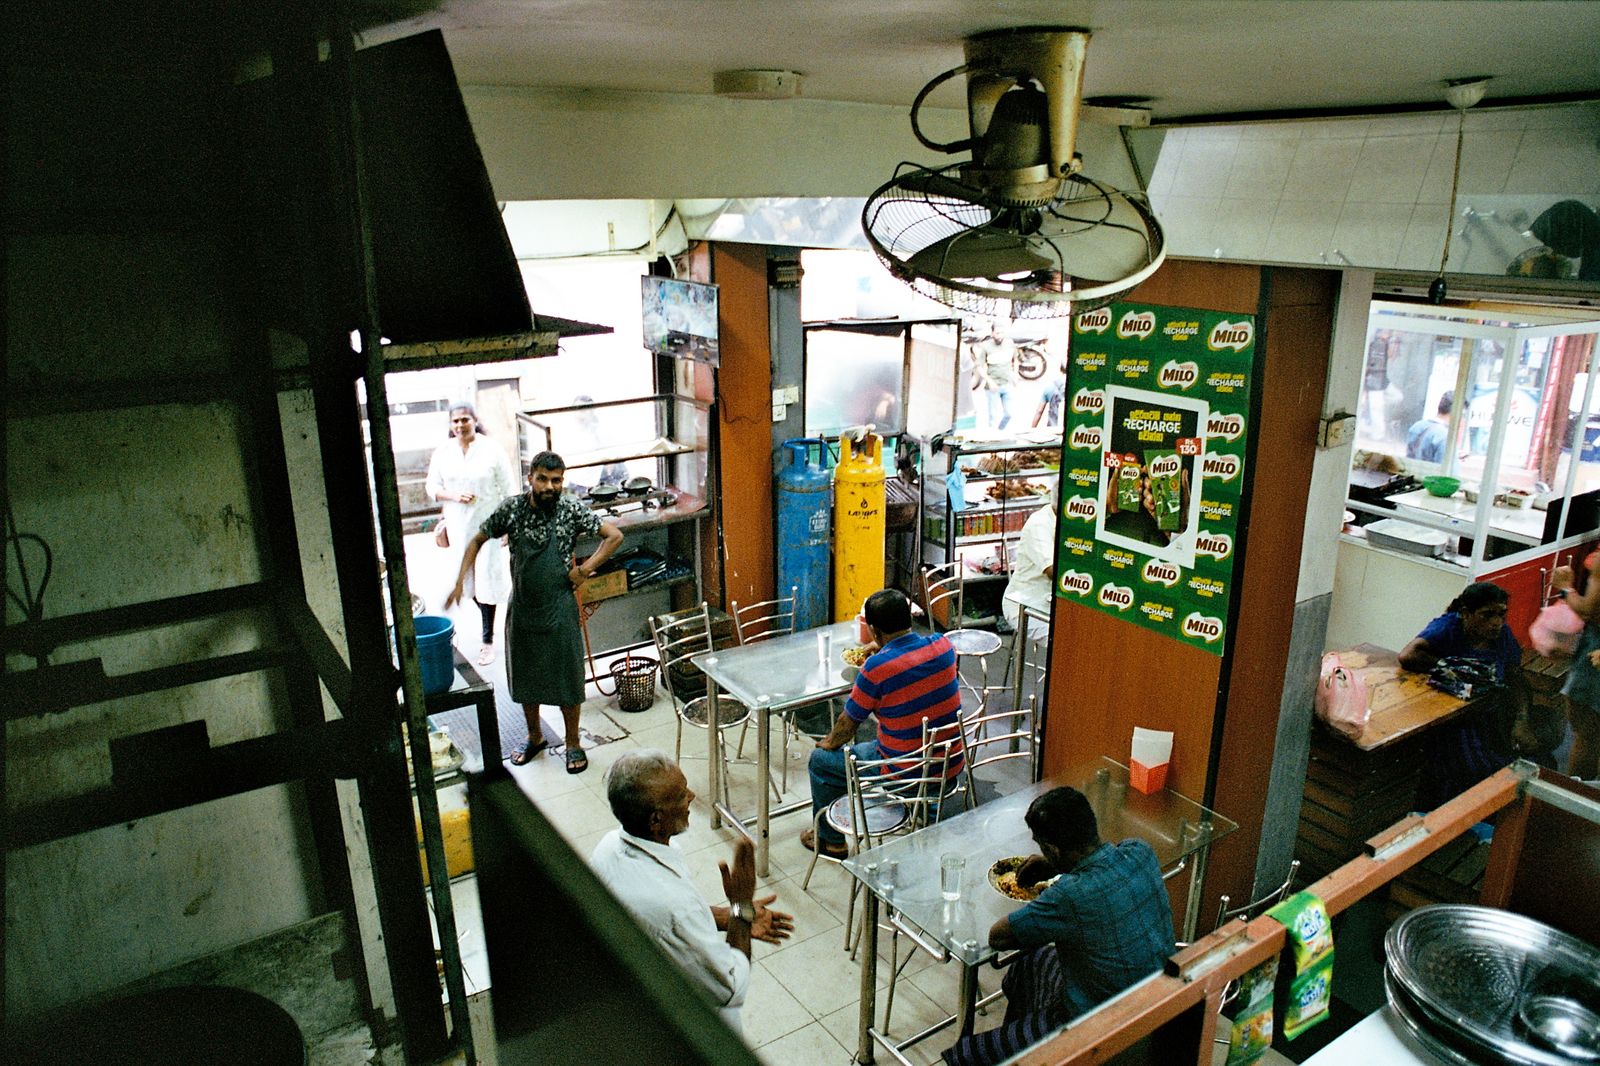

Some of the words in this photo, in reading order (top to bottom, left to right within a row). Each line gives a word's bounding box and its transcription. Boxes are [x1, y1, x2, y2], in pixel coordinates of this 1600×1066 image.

[1080, 315, 1108, 327] MILO
[1122, 320, 1152, 332] MILO
[1213, 330, 1248, 343] MILO
[1163, 369, 1194, 382] MILO
[1206, 378, 1245, 387] RECHARGE
[1076, 395, 1103, 408] MILO
[1123, 418, 1181, 434] RECHARGE
[1207, 419, 1240, 434] MILO
[1073, 432, 1100, 445] MILO
[1180, 445, 1198, 455] 130
[1105, 458, 1120, 467] 100
[1152, 461, 1178, 474] MILO
[1203, 459, 1236, 474] MILO
[1069, 502, 1095, 515] MILO
[1195, 537, 1228, 554] MILO
[1147, 565, 1177, 580] MILO
[1064, 575, 1090, 590] MILO
[1102, 589, 1130, 604] MILO
[1187, 619, 1219, 635] MILO
